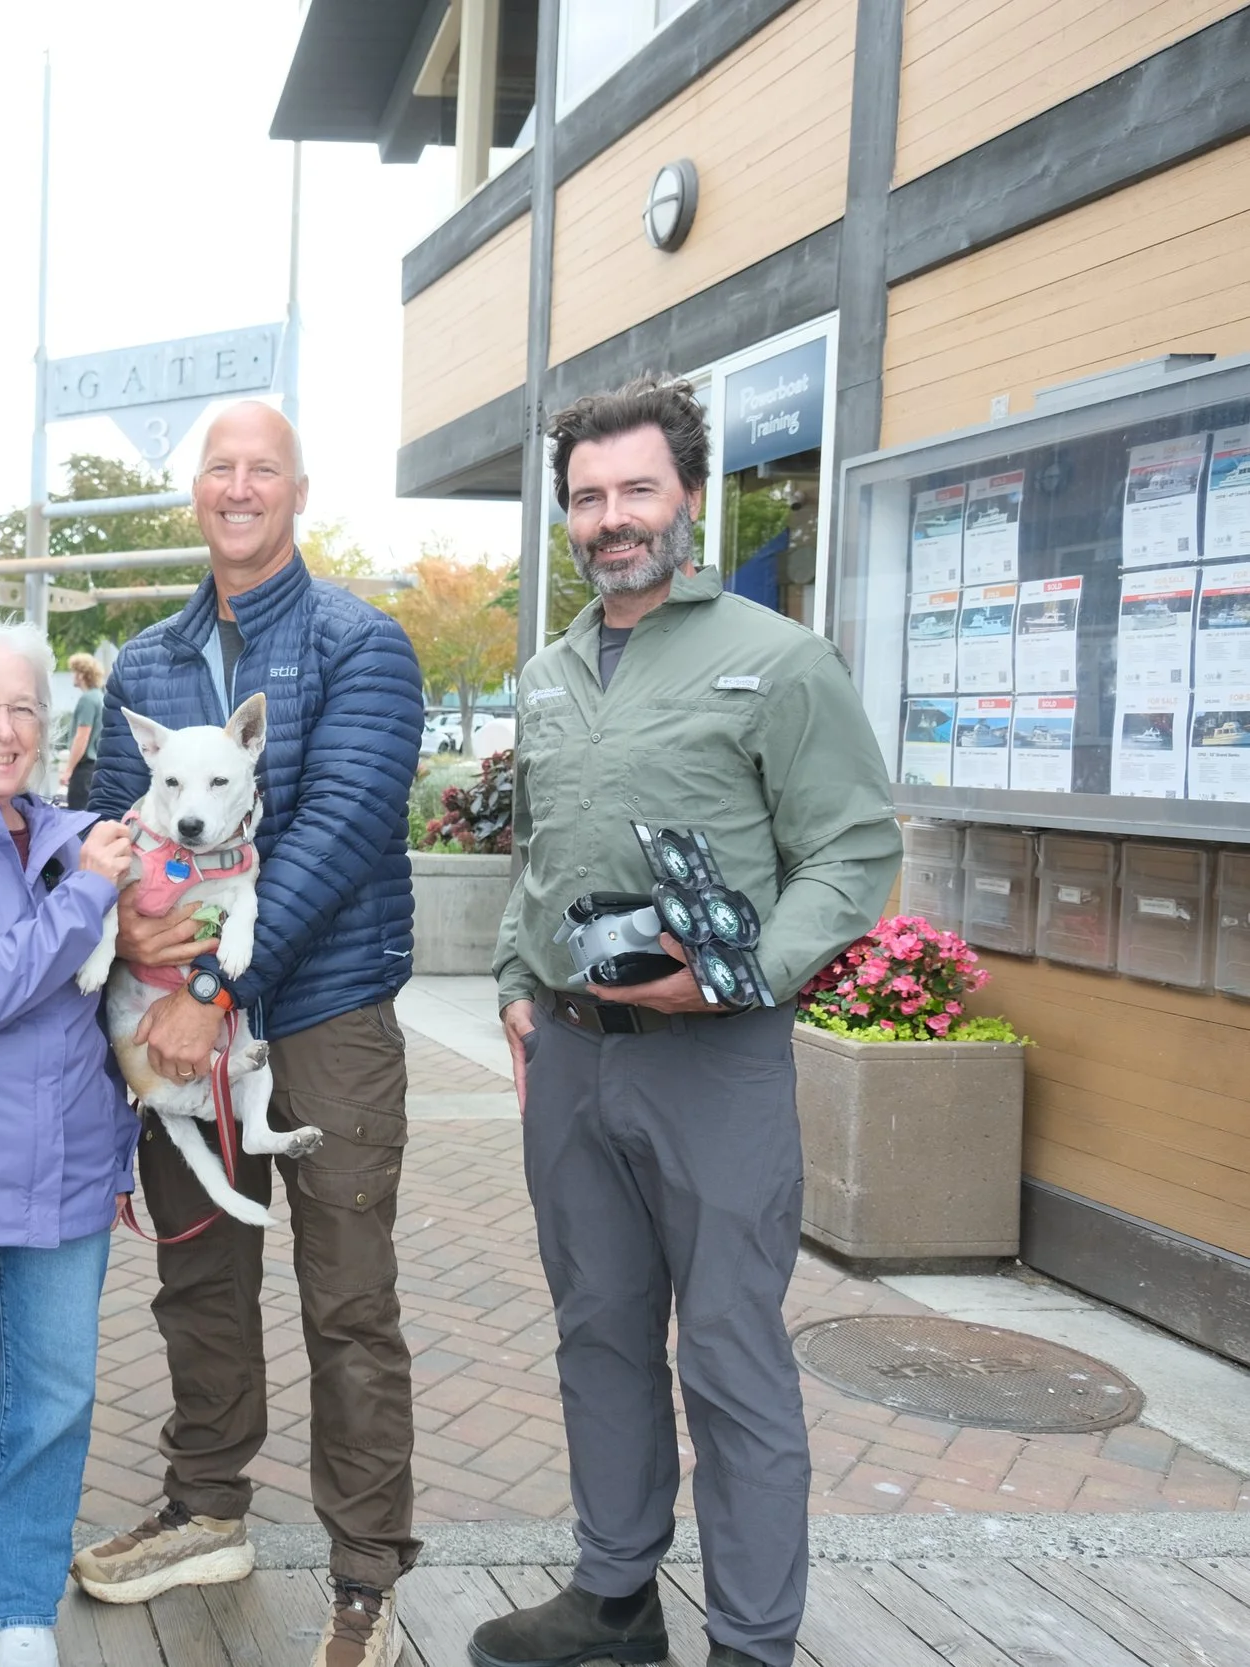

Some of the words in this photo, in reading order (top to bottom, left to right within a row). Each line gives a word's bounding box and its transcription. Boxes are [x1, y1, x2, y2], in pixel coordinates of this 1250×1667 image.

[78, 349, 238, 400] GATE
[740, 373, 809, 419] Powerboat
[142, 416, 171, 460] 3
[746, 410, 800, 445] Training
[1047, 583, 1062, 591] SOLD
[270, 665, 298, 677] stio
[1042, 700, 1057, 708] SOLD
